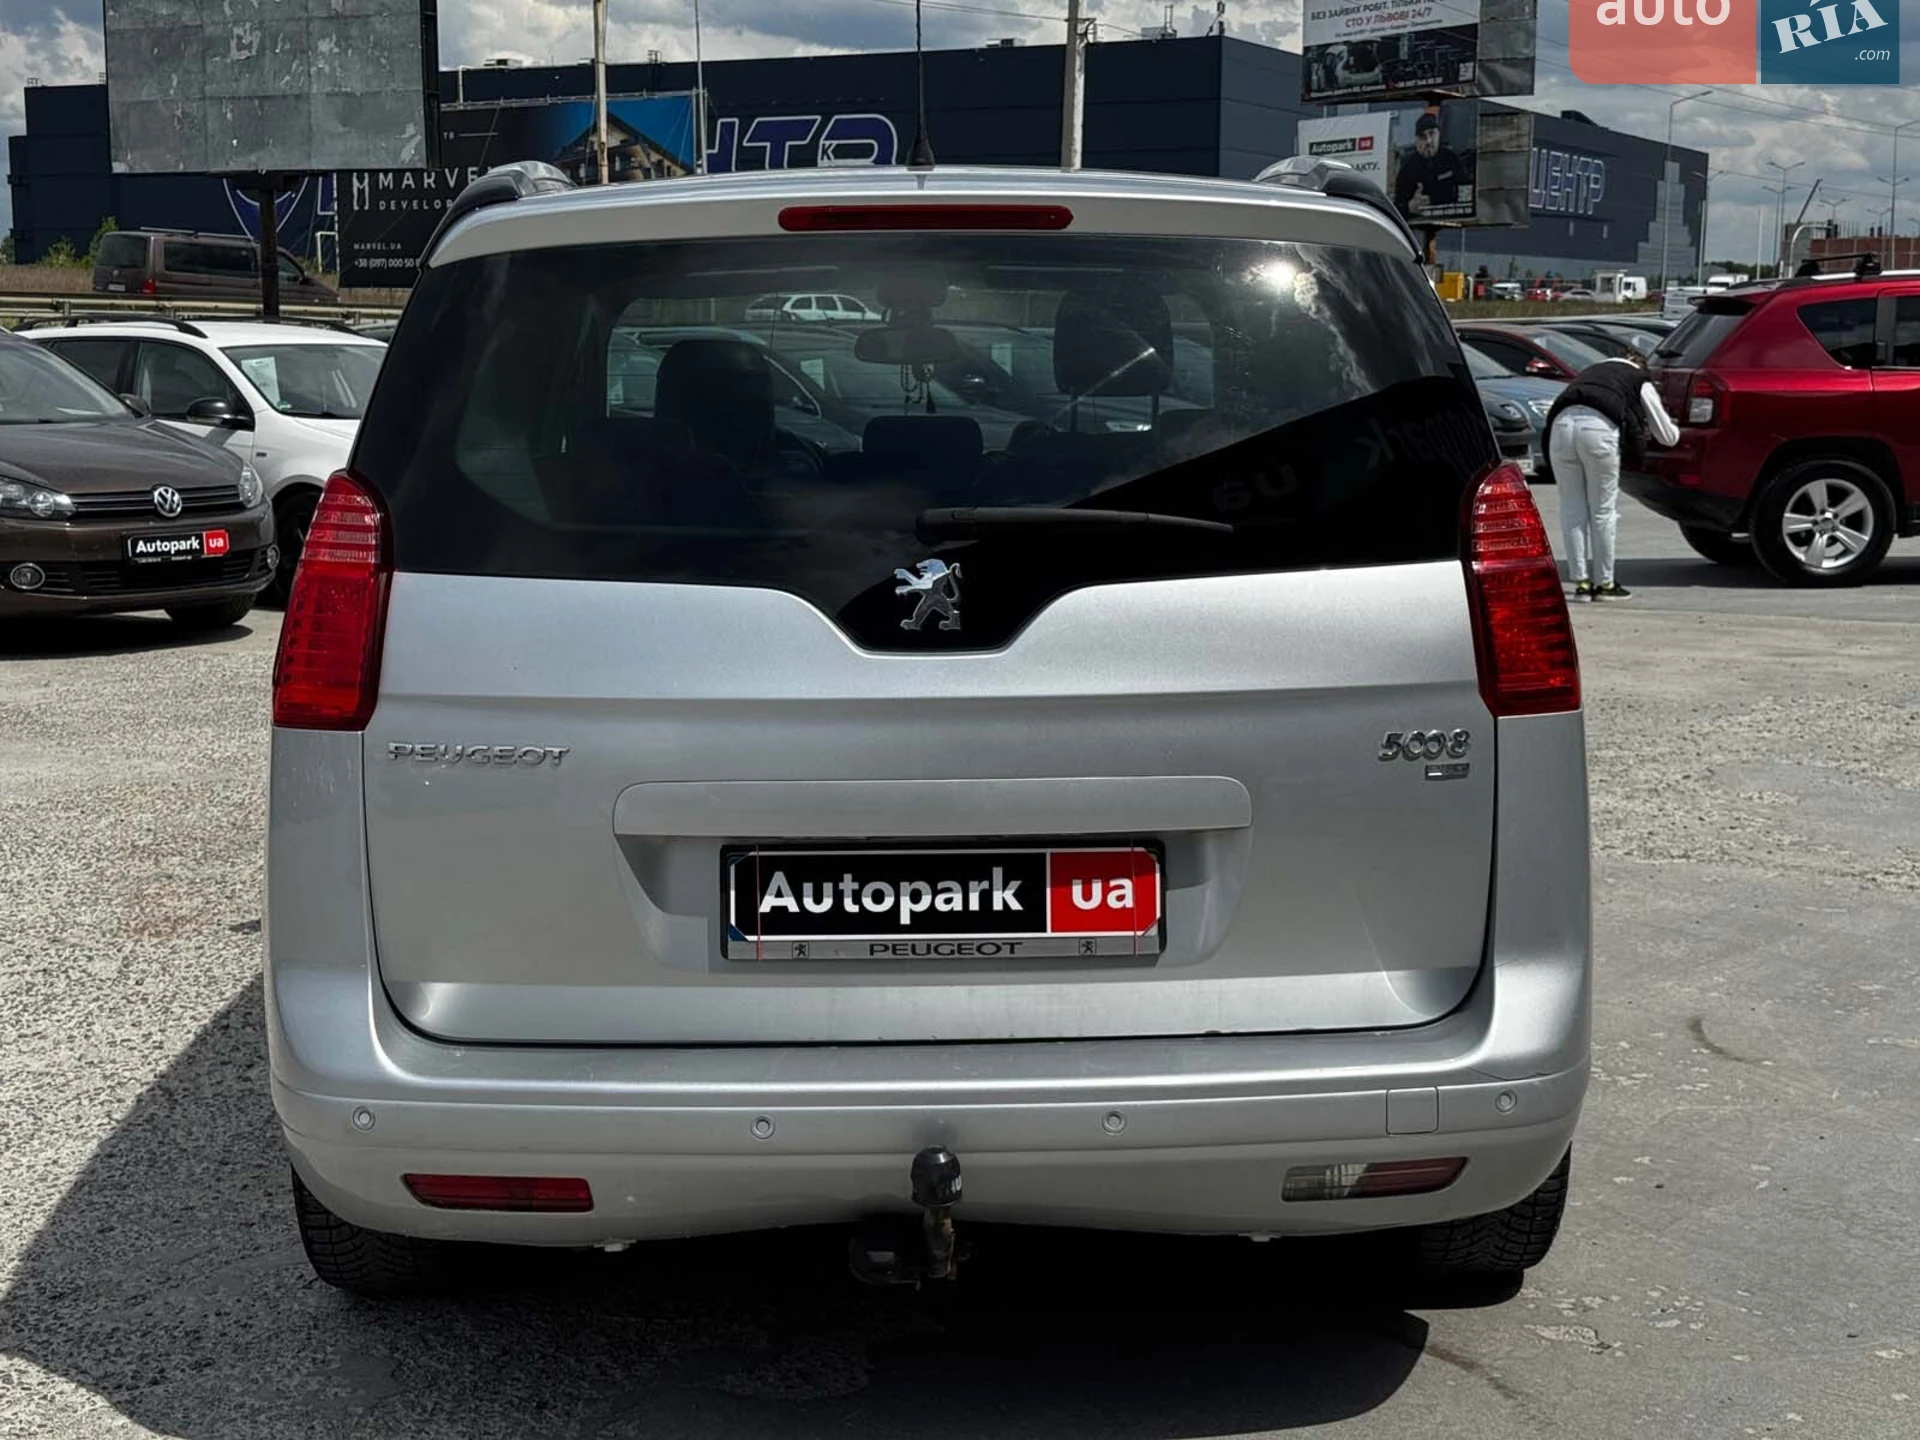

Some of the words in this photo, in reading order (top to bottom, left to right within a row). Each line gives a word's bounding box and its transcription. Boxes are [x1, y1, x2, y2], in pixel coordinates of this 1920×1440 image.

[1310, 11, 1326, 21] БЕЗ
[1345, 16, 1363, 28] СТО
[1365, 14, 1373, 26] У
[1411, 7, 1432, 19] 24/7
[1312, 139, 1354, 154] Autopark
[353, 242, 402, 251] MARVEL.UA
[136, 536, 200, 554] Autopark
[209, 537, 225, 548] ua
[1378, 728, 1471, 762] 5008
[387, 742, 570, 767] PEUGEOT
[758, 866, 1024, 925] Autopark
[1072, 877, 1135, 911] ua
[868, 941, 1024, 957] PEUGEOT
